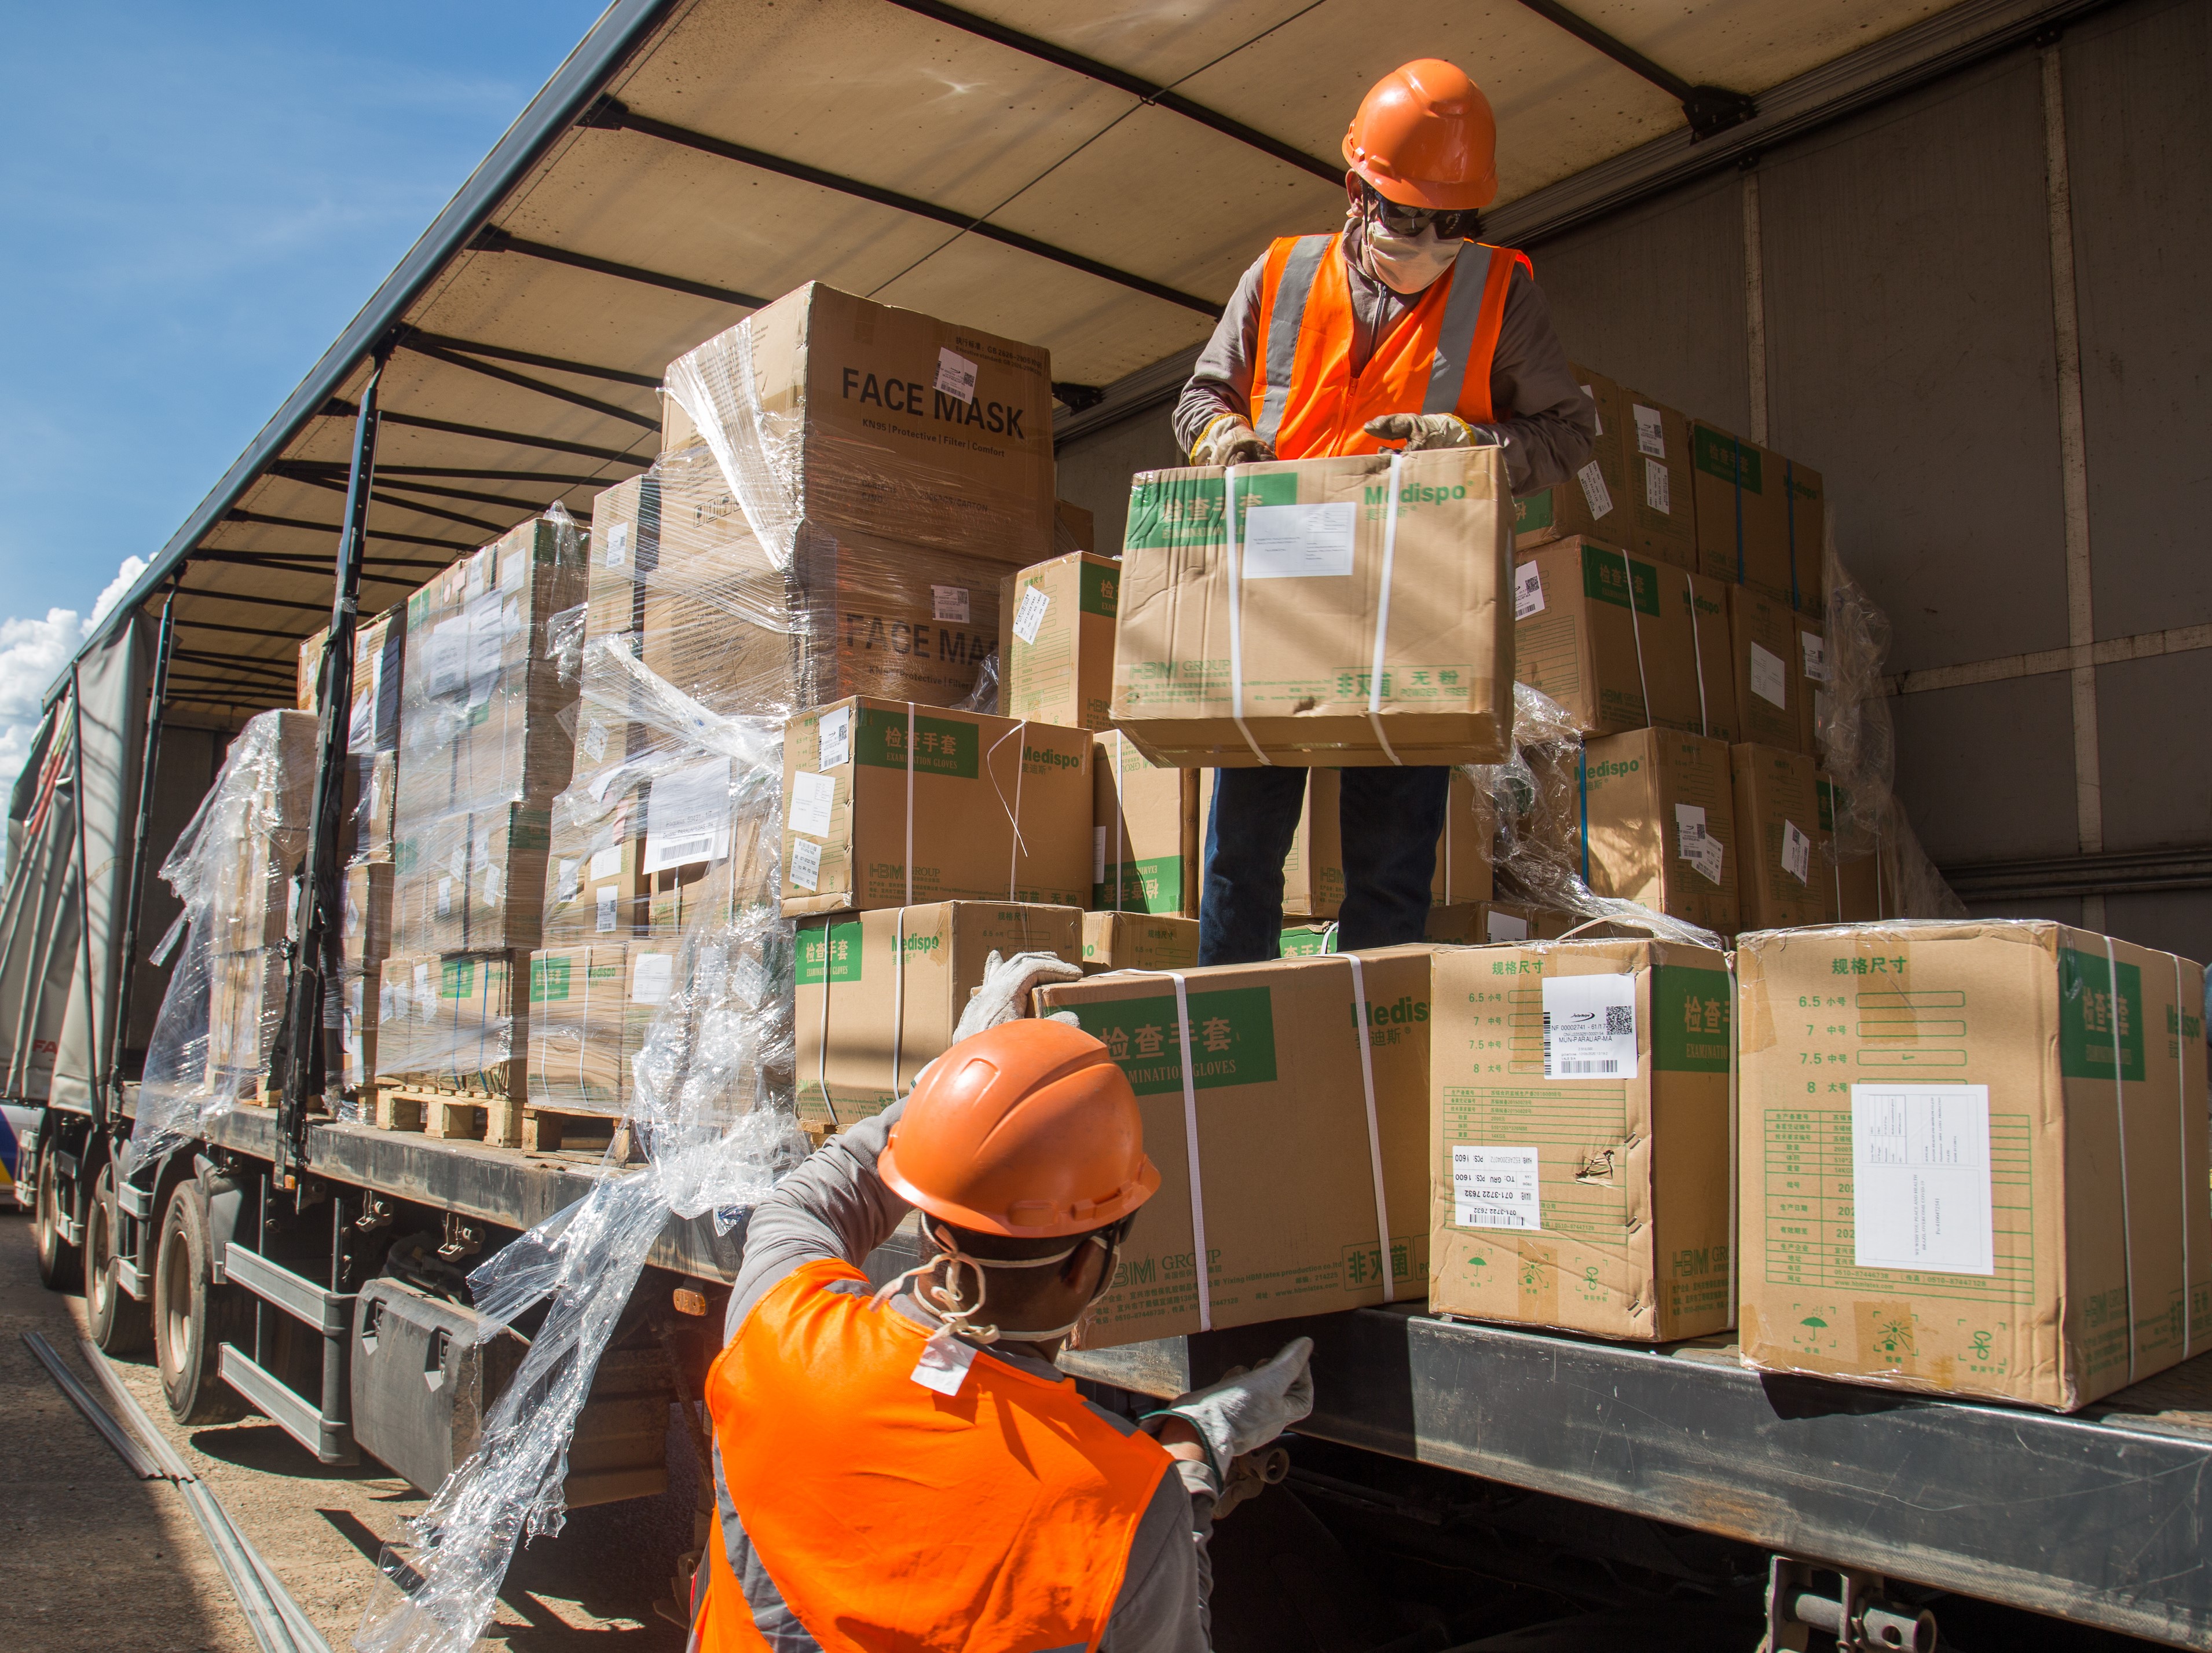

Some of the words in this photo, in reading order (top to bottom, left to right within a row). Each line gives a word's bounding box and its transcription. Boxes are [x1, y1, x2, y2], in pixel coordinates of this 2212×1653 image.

[987, 346, 997, 354] GB
[843, 367, 924, 416] FACE
[934, 386, 1025, 440] MASK
[863, 418, 887, 431] KN95
[892, 426, 936, 443] Protective
[943, 436, 966, 448] Filter
[972, 442, 1005, 457] Comfort
[1364, 482, 1466, 506] Mdispo
[847, 614, 930, 659] FACE
[940, 629, 999, 665] MA
[1130, 661, 1179, 679] HBM
[1183, 659, 1231, 671] GROUP
[885, 726, 957, 755] 检查手套
[933, 759, 957, 769] GLOVES
[1023, 745, 1079, 769] Medispo
[869, 862, 904, 880] HBM
[912, 866, 940, 877] ROUP
[1123, 865, 1157, 876] EXAMINATION
[1103, 878, 1159, 903] 检查手套
[806, 939, 848, 963] 检查手套
[832, 965, 848, 975] GLOVES
[1492, 960, 1544, 975] 规格尺寸
[1832, 956, 1907, 975] 规格尺寸
[1468, 993, 1484, 1003] 6.5
[1799, 996, 1821, 1007] 6.5
[1826, 996, 1846, 1007] 小号
[1350, 996, 1430, 1028] Medis
[1684, 996, 1730, 1034] 检查
[1474, 1016, 1479, 1026] 7
[1488, 1017, 1501, 1025] 中号
[1806, 1025, 1814, 1036] 7
[1826, 1025, 1846, 1036] 中号
[1100, 1016, 1232, 1061] 检查手套
[1469, 1040, 1484, 1049] 7.5
[1488, 1041, 1501, 1049] 中号
[1686, 1043, 1728, 1059] EXAMINATIO
[1800, 1053, 1822, 1065] 7.5
[1828, 1054, 1847, 1065] 中号
[1130, 1065, 1183, 1084] MINATIO
[1192, 1059, 1236, 1077] GLOVES
[1474, 1064, 1479, 1073] 8
[1807, 1082, 1815, 1093] 8
[1828, 1082, 1847, 1093] 大号
[1455, 1154, 1469, 1162] 1600
[1464, 1190, 1481, 1198] 7632
[1482, 1190, 1513, 1199] 071-3722
[1780, 1204, 1807, 1212] 生产日期
[1780, 1244, 1809, 1252] 生产企业
[1348, 1245, 1408, 1284] 非灭菌
[1672, 1246, 1709, 1278] HBM
[1112, 1252, 1156, 1288] BM
[1834, 1269, 1889, 1279] 0510-87446738
[1102, 1294, 1126, 1304] 产企业：
[1223, 1277, 1245, 1285] Yixing
[1246, 1273, 1262, 1282] HBM
[1263, 1271, 1280, 1280] latex
[1276, 1282, 1338, 1297] www.hbmlatex.com
[1834, 1279, 1894, 1290] www.hbmlatex.com
